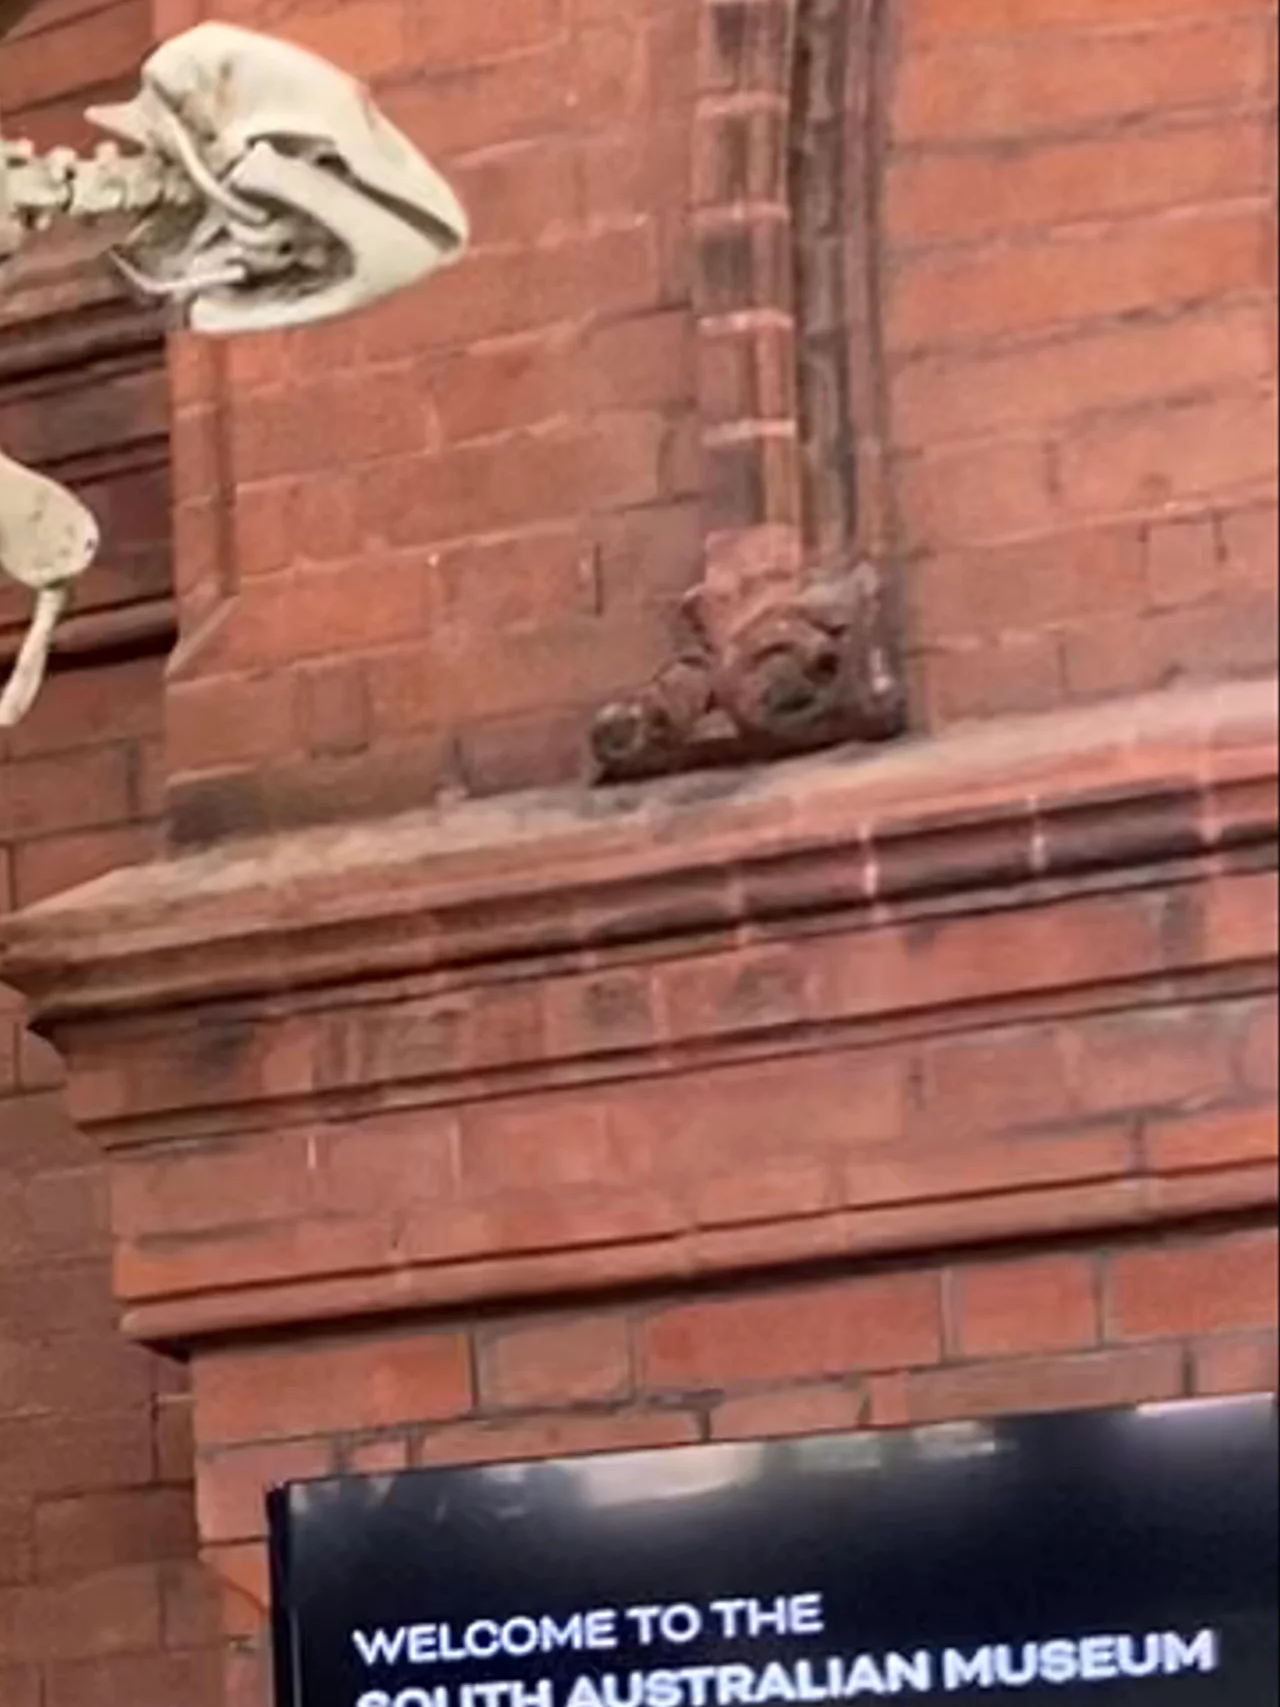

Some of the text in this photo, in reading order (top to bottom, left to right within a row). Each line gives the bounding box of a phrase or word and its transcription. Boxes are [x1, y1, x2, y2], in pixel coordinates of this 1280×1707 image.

[352, 1592, 824, 1666] WELCOME TO THE
[942, 1628, 1217, 1691] MUSEUM
